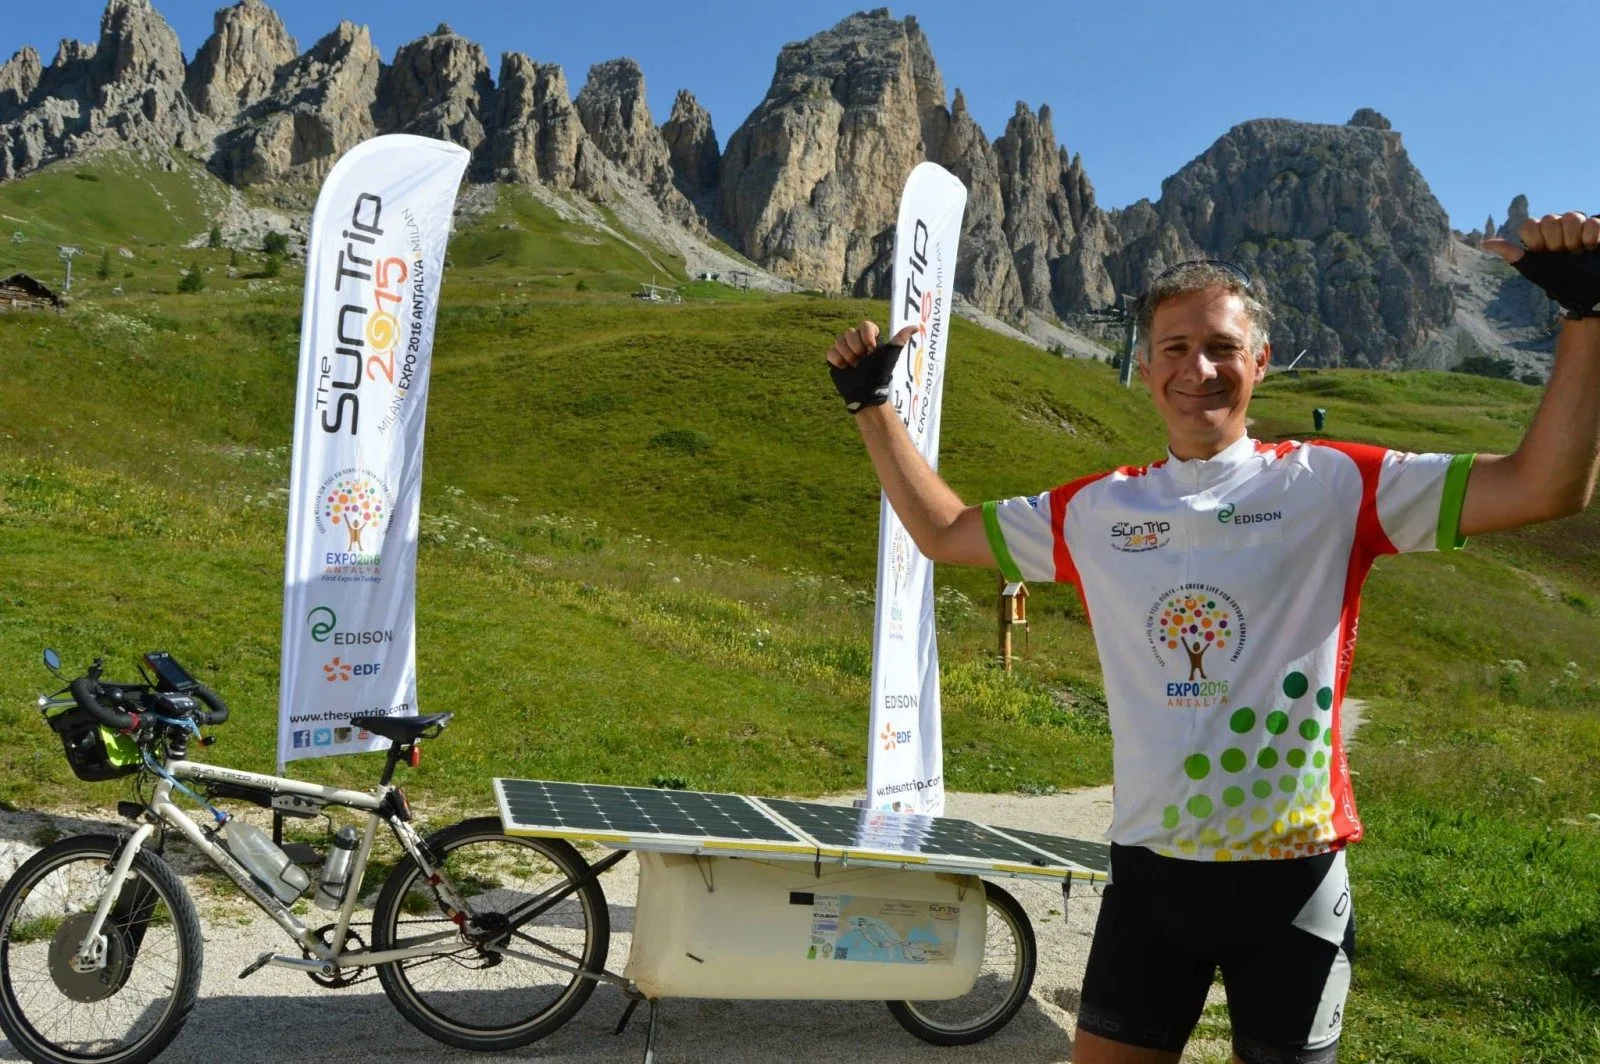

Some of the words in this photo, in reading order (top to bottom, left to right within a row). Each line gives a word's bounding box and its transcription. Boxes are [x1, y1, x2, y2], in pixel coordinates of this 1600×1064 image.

[400, 207, 422, 252] MILAN
[413, 259, 425, 320] ANTALYA
[365, 256, 409, 385] 2015
[409, 322, 423, 352] 2016
[315, 356, 331, 410] The
[398, 354, 417, 390] EXPO
[917, 396, 929, 436] EXPO
[925, 362, 935, 396] 2016
[377, 395, 404, 434] MILAN
[1111, 525, 1143, 537] Sun
[1144, 520, 1171, 534] Trip
[1234, 511, 1282, 525] EDISON
[1124, 533, 1158, 547] 2015
[325, 566, 380, 574] ANTALYA
[1219, 591, 1231, 602] FOR
[1229, 600, 1245, 621] FUTURE
[334, 630, 393, 645] EDISON
[885, 695, 918, 709] EDISON
[1168, 695, 1229, 708] ANTALYA
[221, 771, 252, 781] TRIP
[256, 777, 279, 787] 2015
